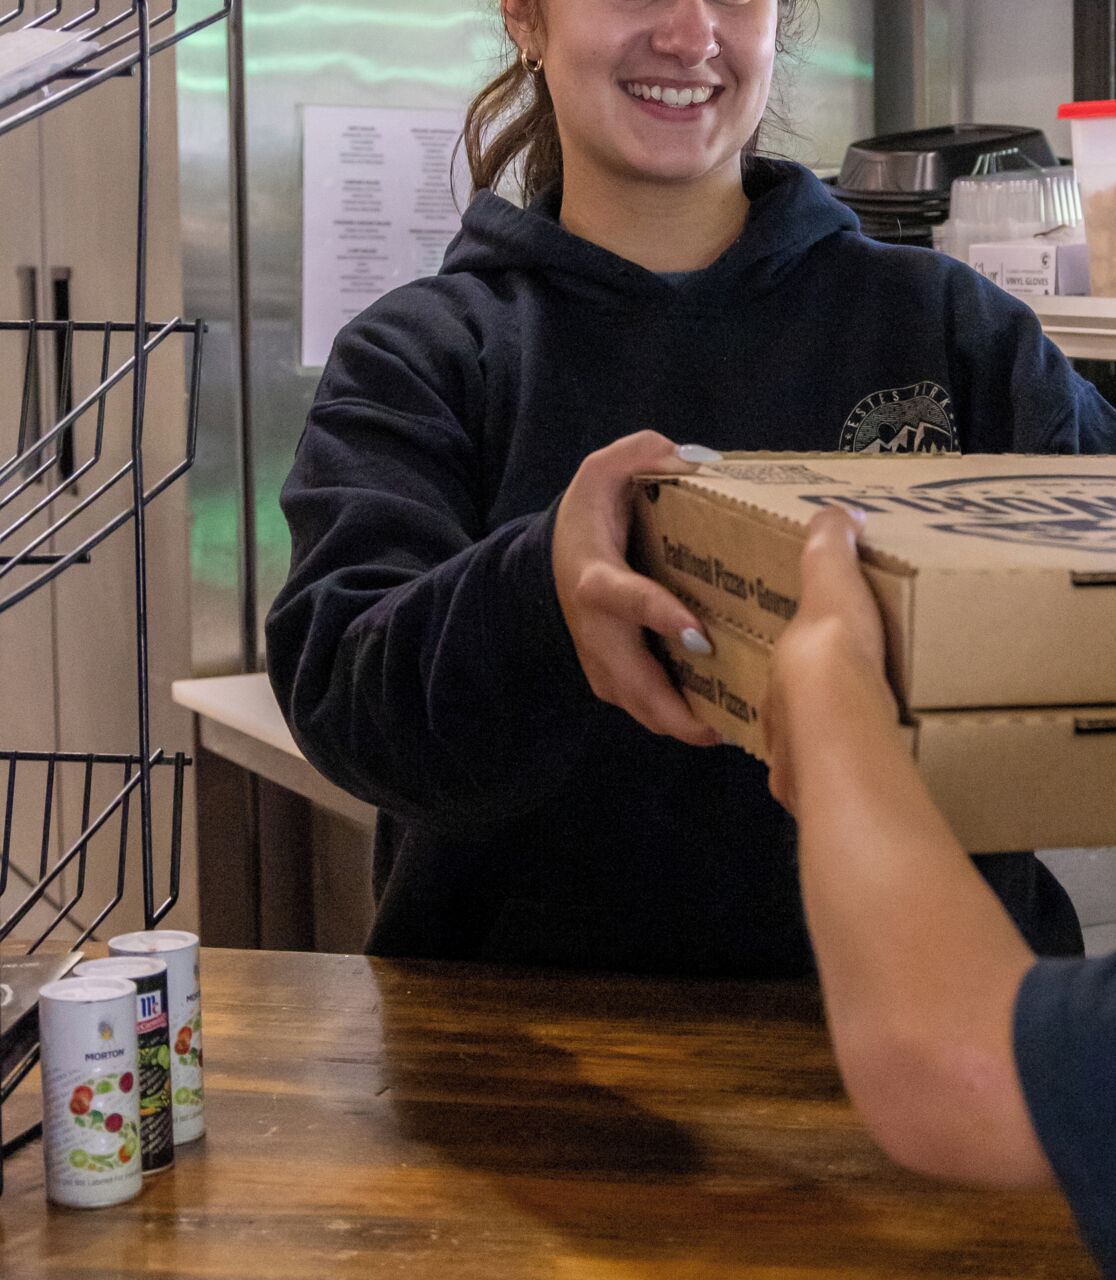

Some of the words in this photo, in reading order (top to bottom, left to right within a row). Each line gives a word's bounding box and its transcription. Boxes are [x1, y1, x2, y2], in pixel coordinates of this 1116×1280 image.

[1006, 278, 1023, 286] VINYL
[1025, 277, 1049, 286] GLOVES
[847, 391, 900, 428] ESTES
[663, 535, 714, 586] Traditional
[714, 557, 748, 601] Pizzas
[718, 678, 750, 723] Pizzas
[85, 1048, 125, 1062] MORTON
